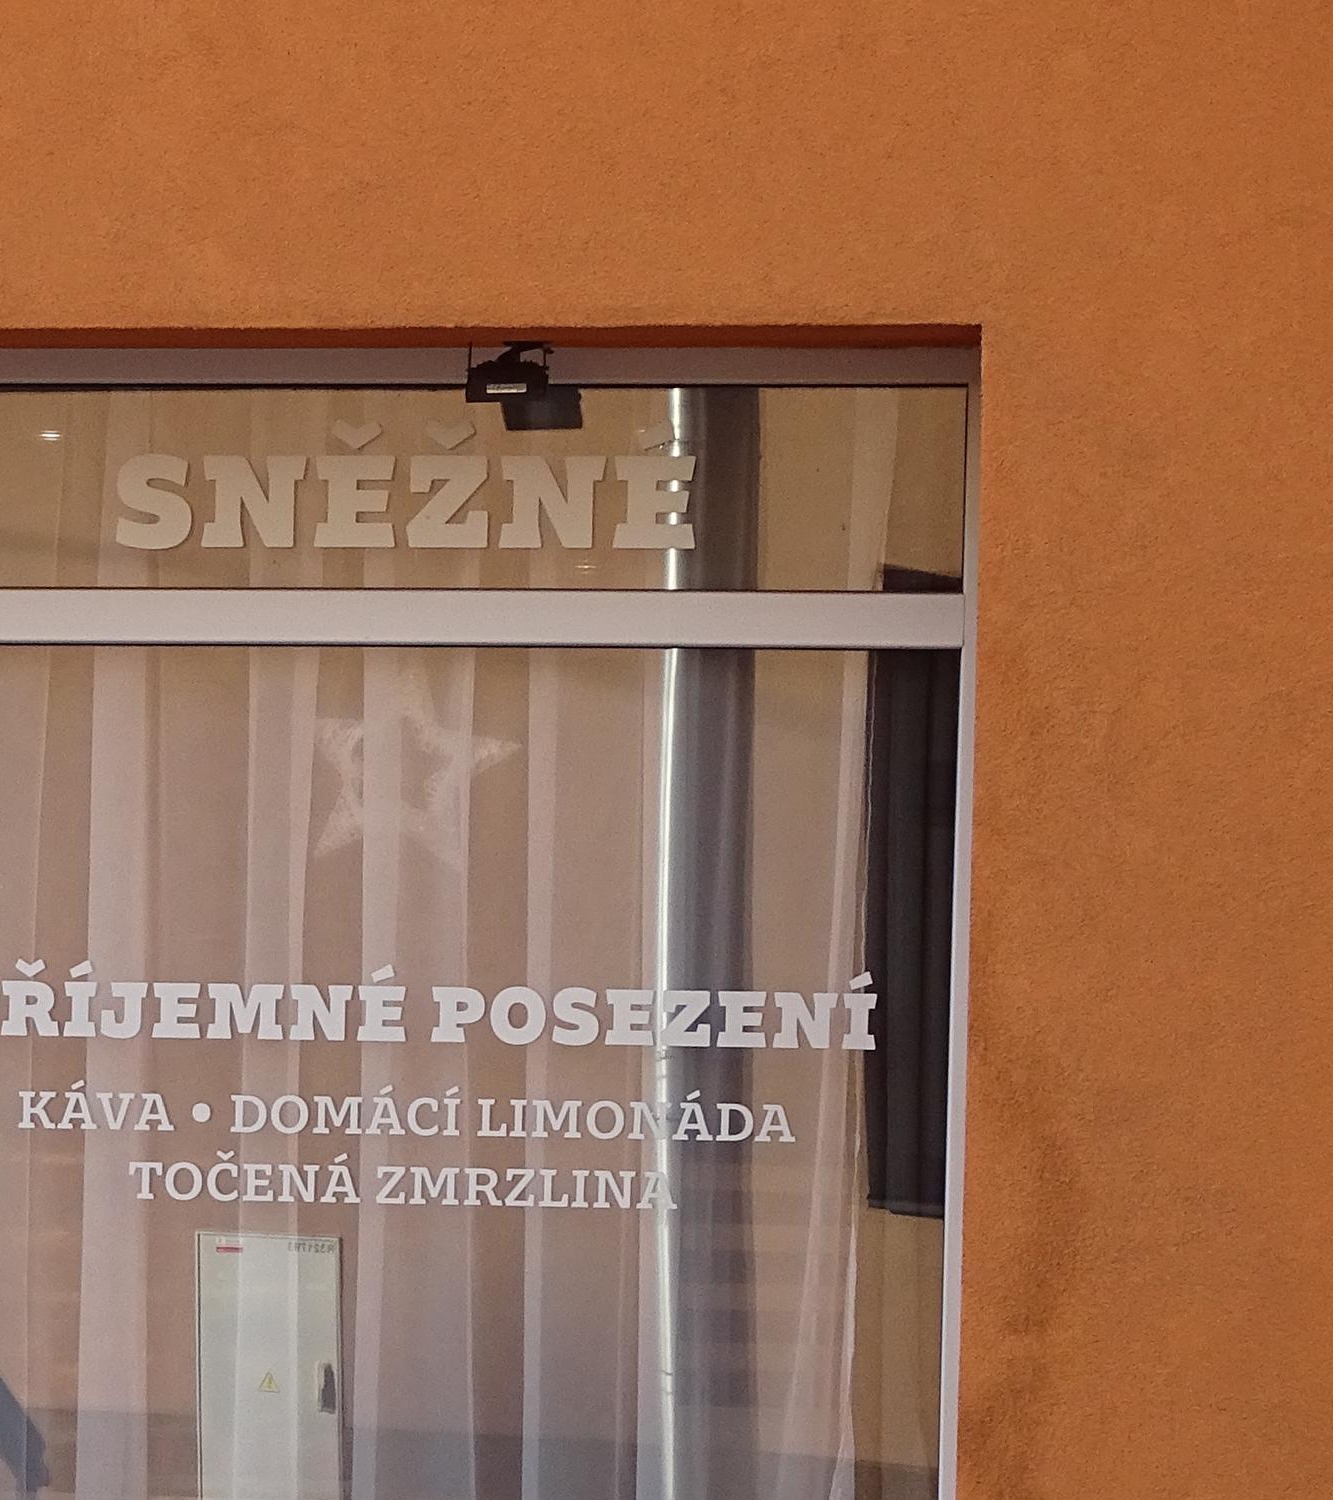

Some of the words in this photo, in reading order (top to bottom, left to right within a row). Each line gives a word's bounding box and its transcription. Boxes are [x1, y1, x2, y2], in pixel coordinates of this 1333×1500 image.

[115, 416, 697, 551] SNĚŽNÉ
[430, 971, 879, 1051] POSEZENÍ
[17, 1079, 175, 1132] KÁVA
[229, 1084, 461, 1137] DOMÁCÍ
[476, 1089, 796, 1143] LIMONÁDA
[128, 1150, 361, 1204] TOČENÁ
[376, 1165, 677, 1210] ZMRZLINA
